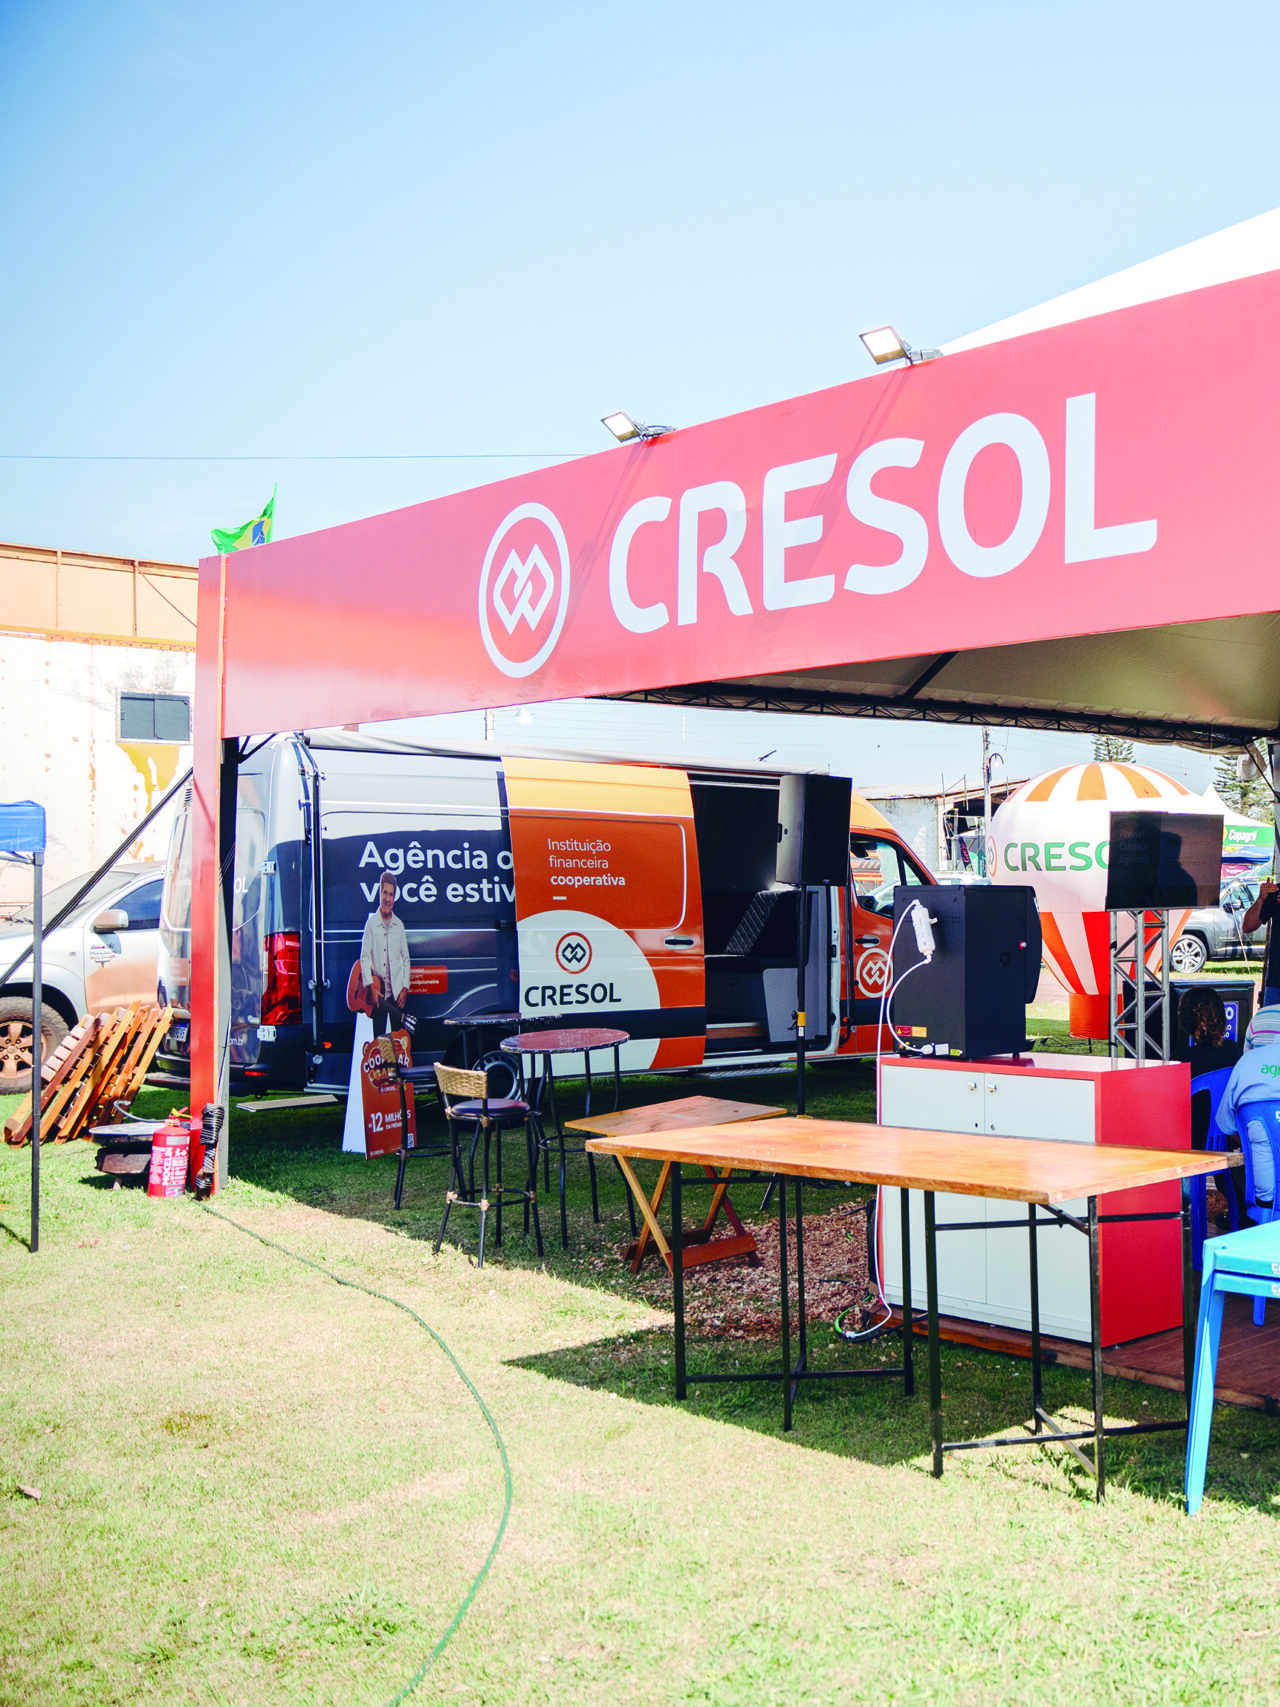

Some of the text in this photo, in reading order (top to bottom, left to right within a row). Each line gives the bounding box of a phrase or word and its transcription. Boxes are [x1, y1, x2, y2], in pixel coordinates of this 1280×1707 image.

[608, 392, 1158, 634] CRESOL
[548, 838, 611, 854] Instituição
[359, 840, 488, 875] Agência
[549, 855, 609, 869] financeira
[550, 874, 626, 888] cooperativa
[524, 983, 622, 1007] CRESOL
